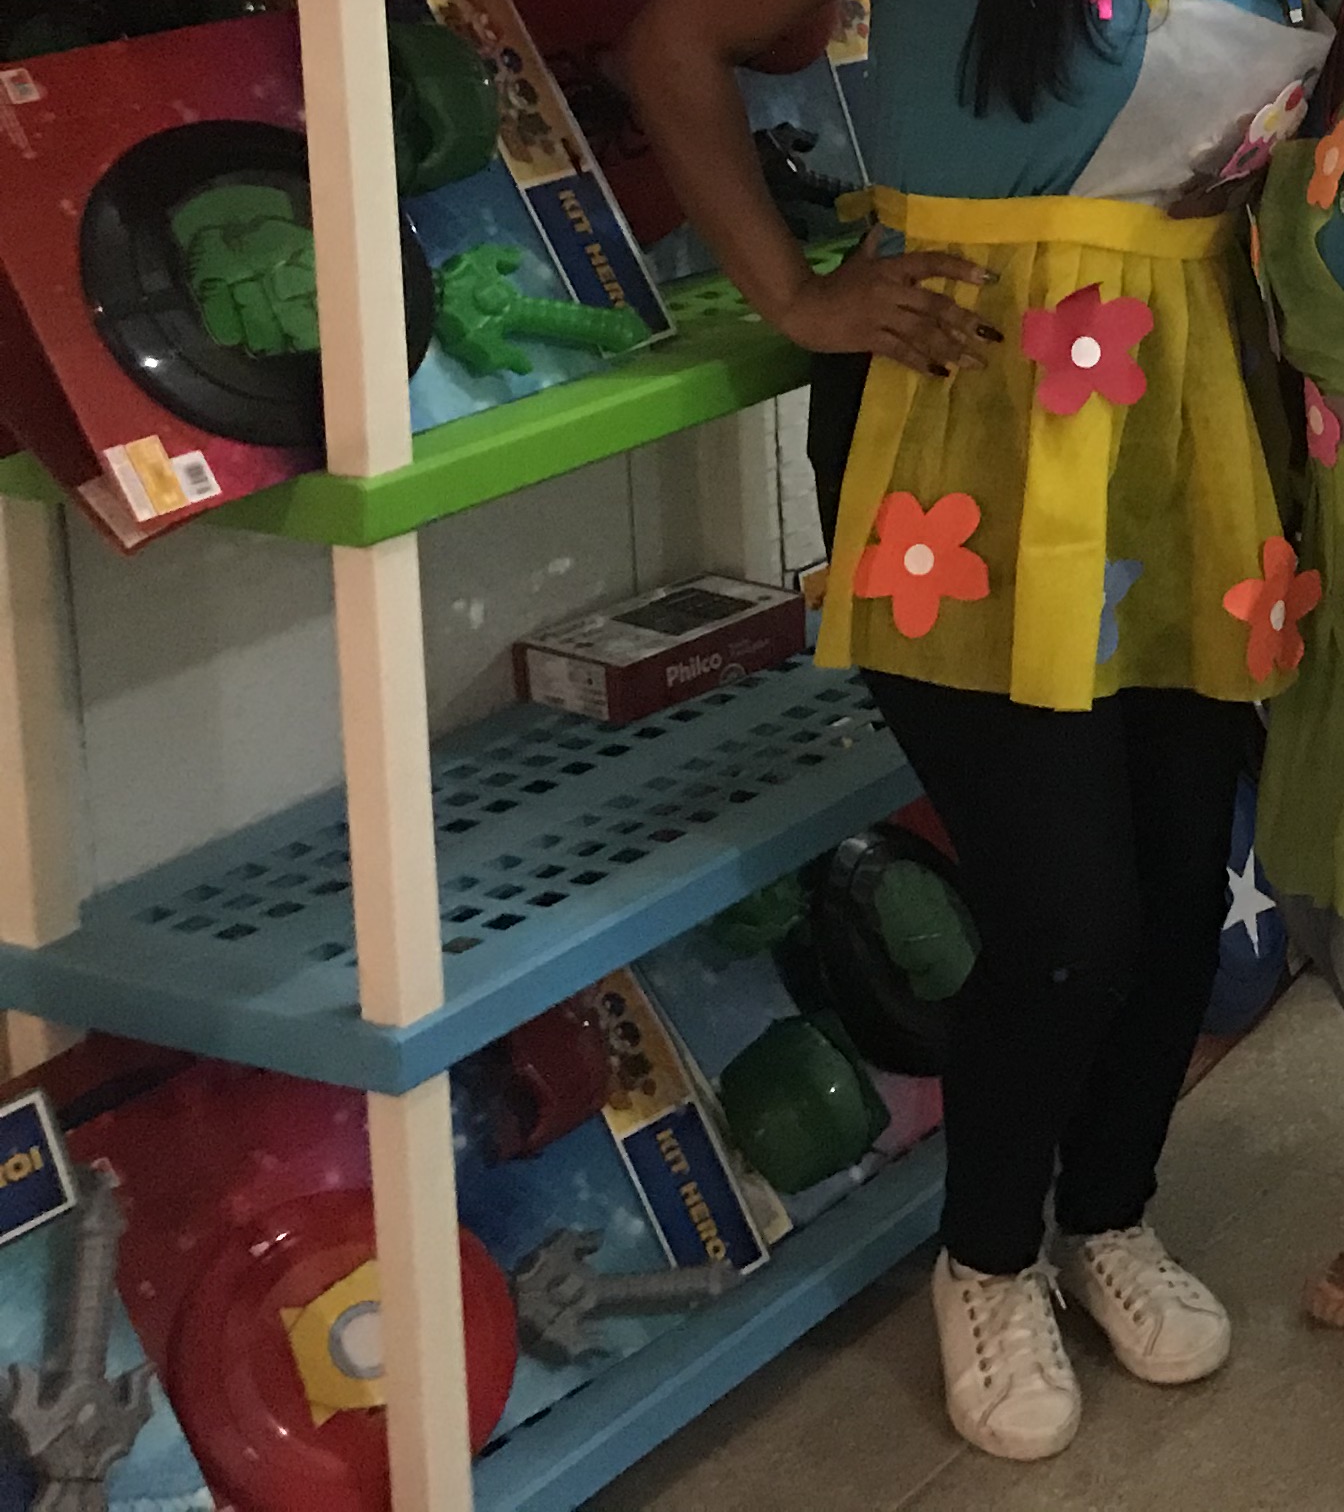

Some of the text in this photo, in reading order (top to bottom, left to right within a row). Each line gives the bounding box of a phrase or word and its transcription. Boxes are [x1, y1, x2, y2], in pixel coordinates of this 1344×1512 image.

[558, 189, 593, 235] KIT
[665, 651, 723, 688] Philco
[655, 1127, 733, 1269] KIT HERÓ
